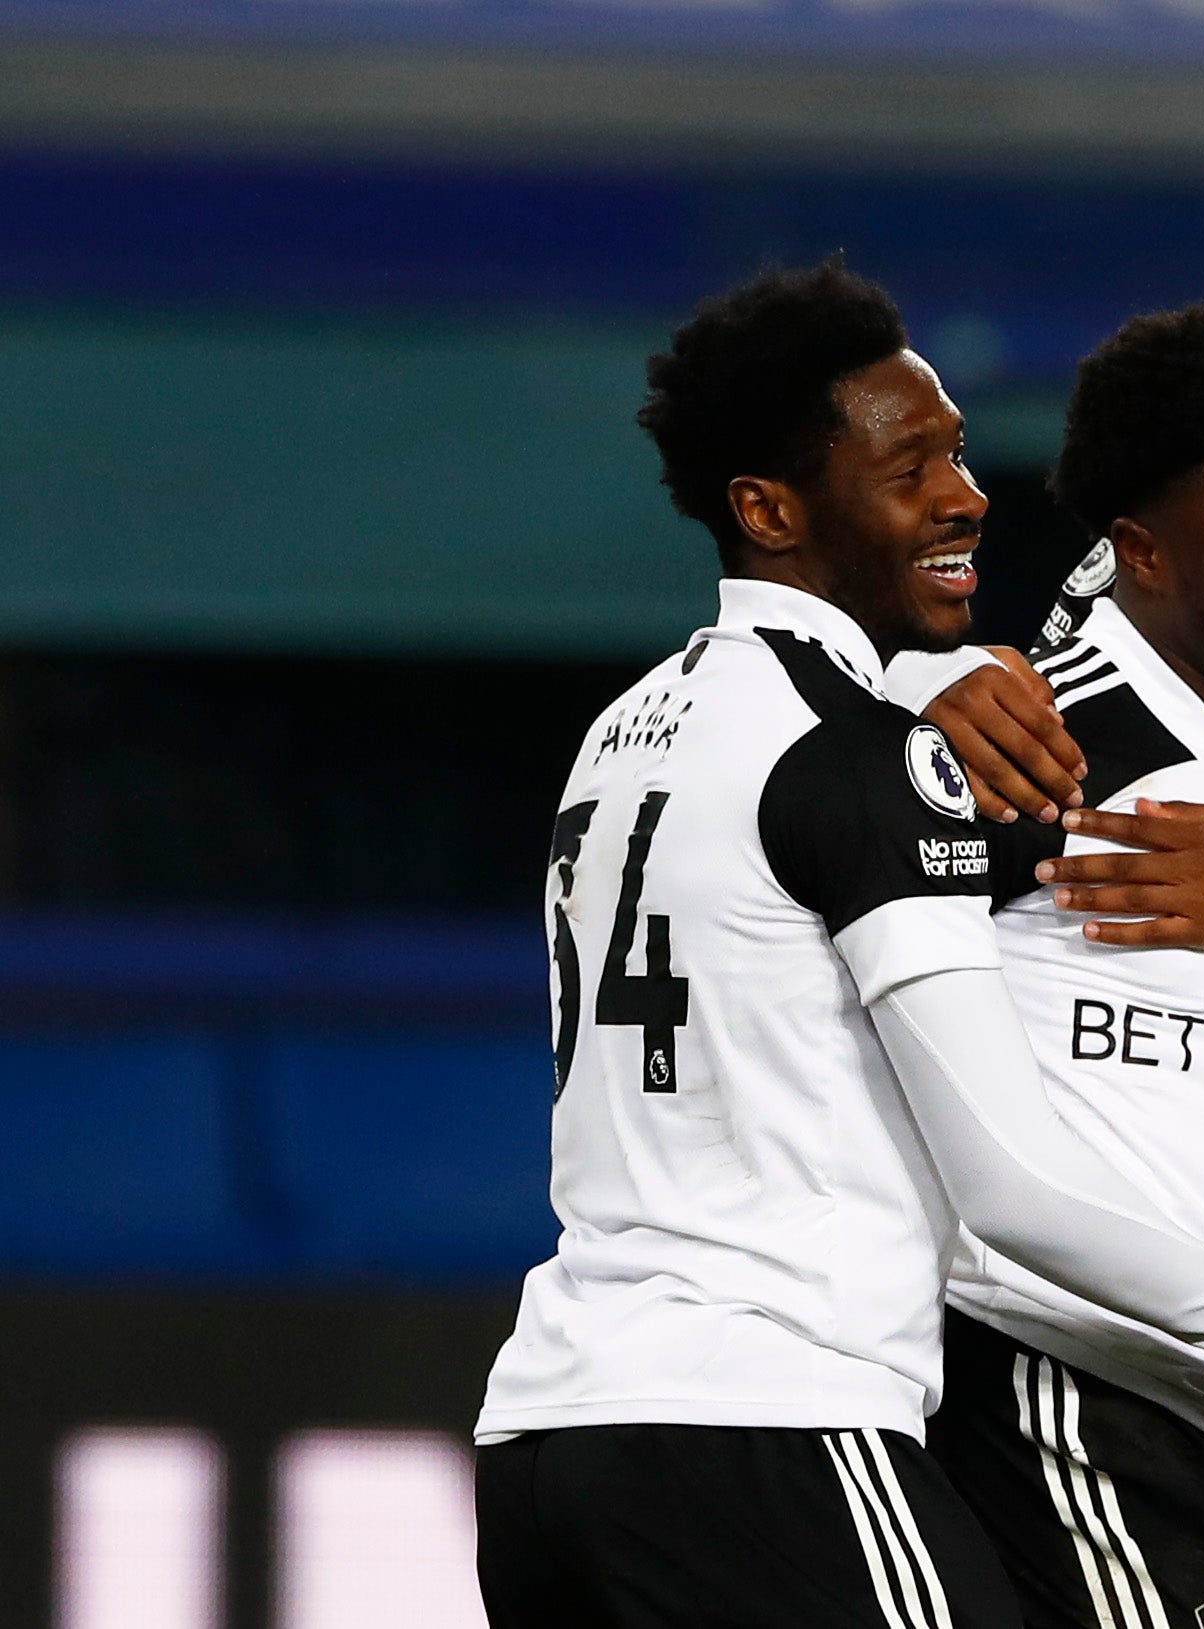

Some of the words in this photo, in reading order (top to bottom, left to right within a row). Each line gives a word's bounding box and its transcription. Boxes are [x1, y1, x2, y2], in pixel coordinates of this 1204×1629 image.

[918, 838, 949, 859] No
[952, 839, 987, 858] room
[922, 858, 949, 876] for
